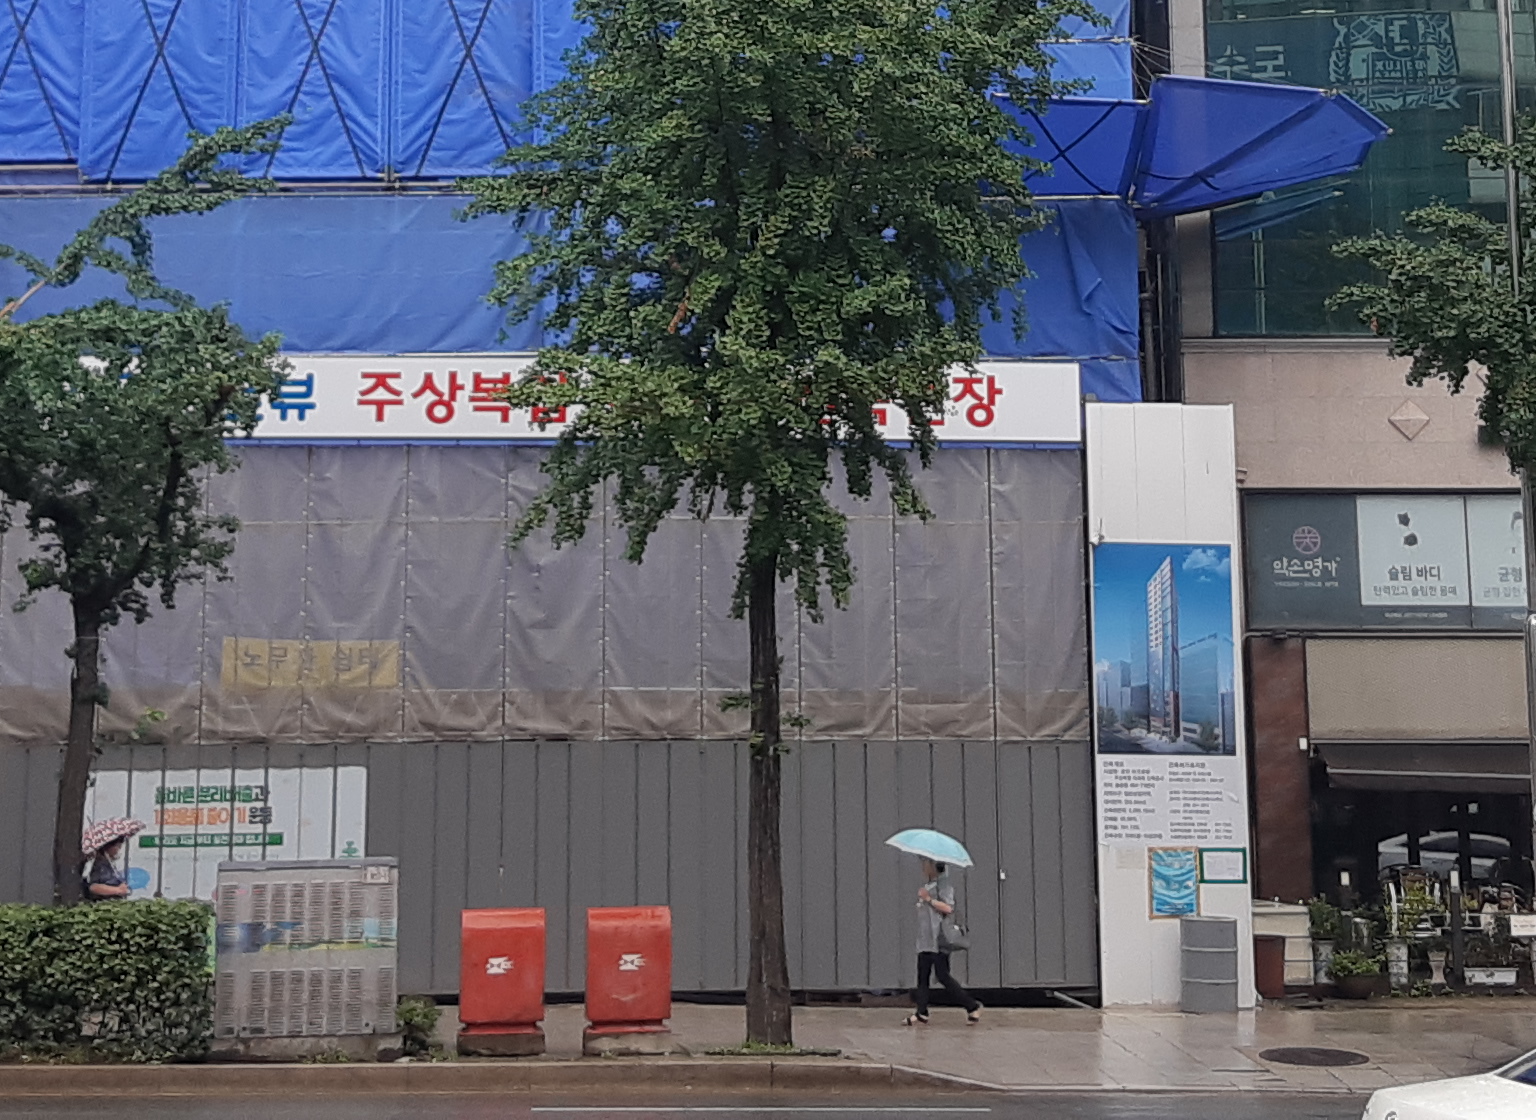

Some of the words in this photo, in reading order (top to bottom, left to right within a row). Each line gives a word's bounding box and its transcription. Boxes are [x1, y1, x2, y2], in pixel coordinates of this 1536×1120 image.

[1272, 556, 1339, 578] 약손명가
[1387, 565, 1413, 582] 슬림
[1415, 565, 1442, 582] 바디
